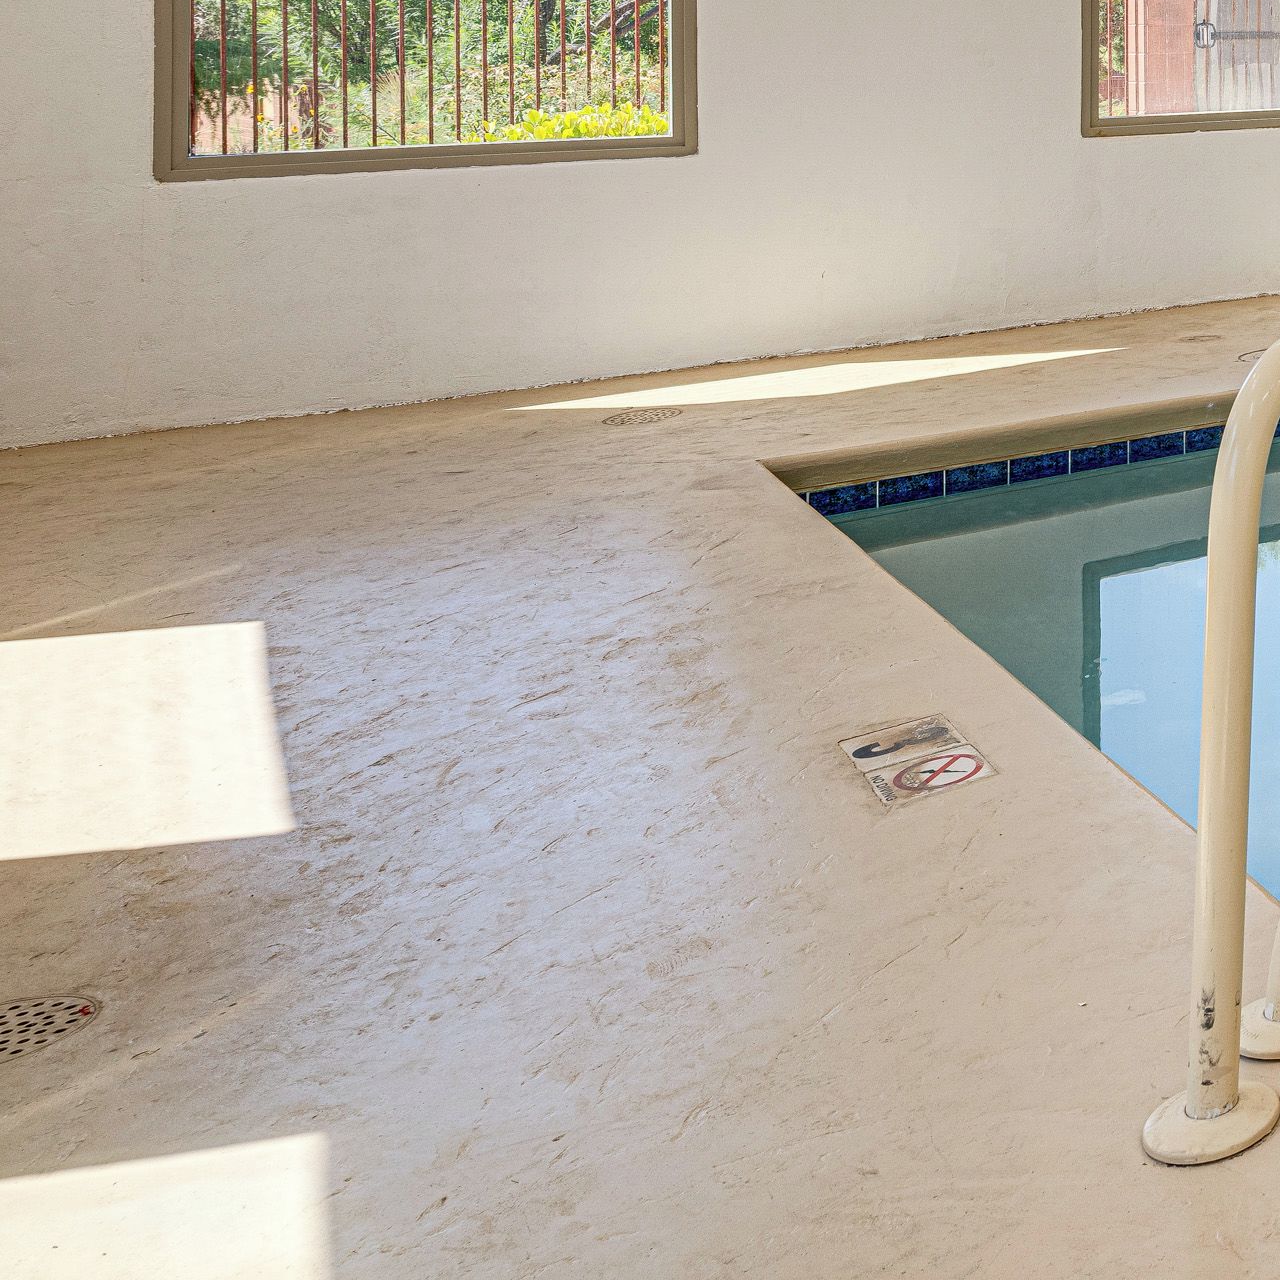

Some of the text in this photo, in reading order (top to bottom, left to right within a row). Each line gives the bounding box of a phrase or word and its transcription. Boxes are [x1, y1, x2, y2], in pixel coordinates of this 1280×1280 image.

[852, 726, 948, 758] 3
[871, 775, 897, 802] NO DIVING
